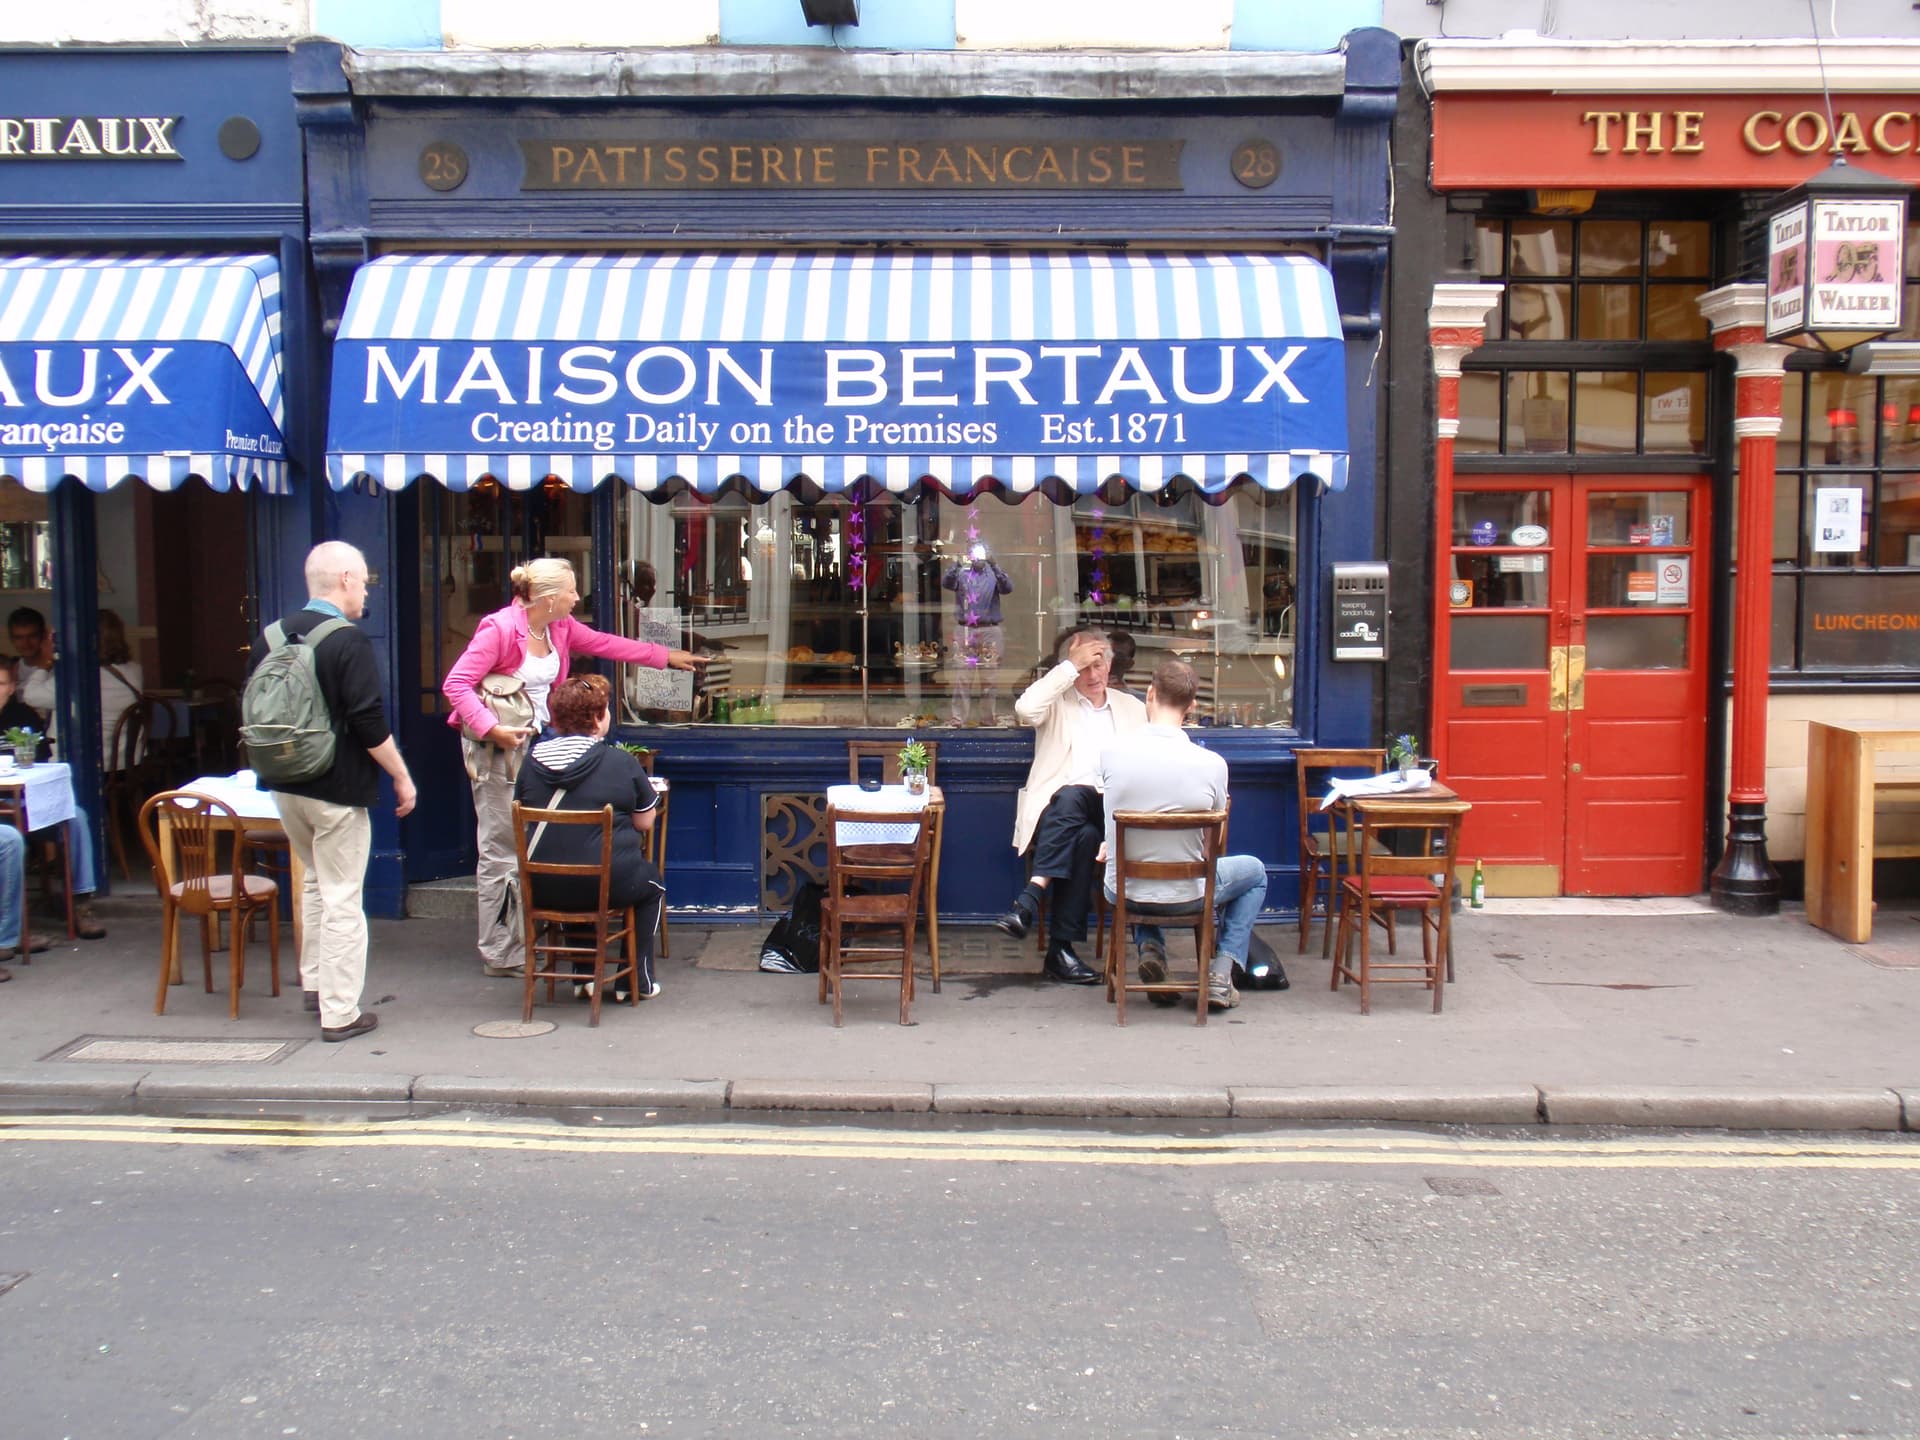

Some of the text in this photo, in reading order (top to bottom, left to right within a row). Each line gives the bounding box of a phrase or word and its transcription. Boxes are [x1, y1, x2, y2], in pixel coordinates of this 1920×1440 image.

[1583, 110, 1920, 154] THE COAC
[423, 152, 461, 181] 28
[550, 145, 1147, 184] PATISSERIE FRANCAISE
[1238, 150, 1276, 179] 28
[362, 345, 1311, 407] MAISON BERTAUX
[471, 412, 615, 449] Creating
[625, 412, 720, 452] Daily
[729, 420, 772, 444] on
[782, 416, 836, 445] the
[844, 412, 998, 445] Premises
